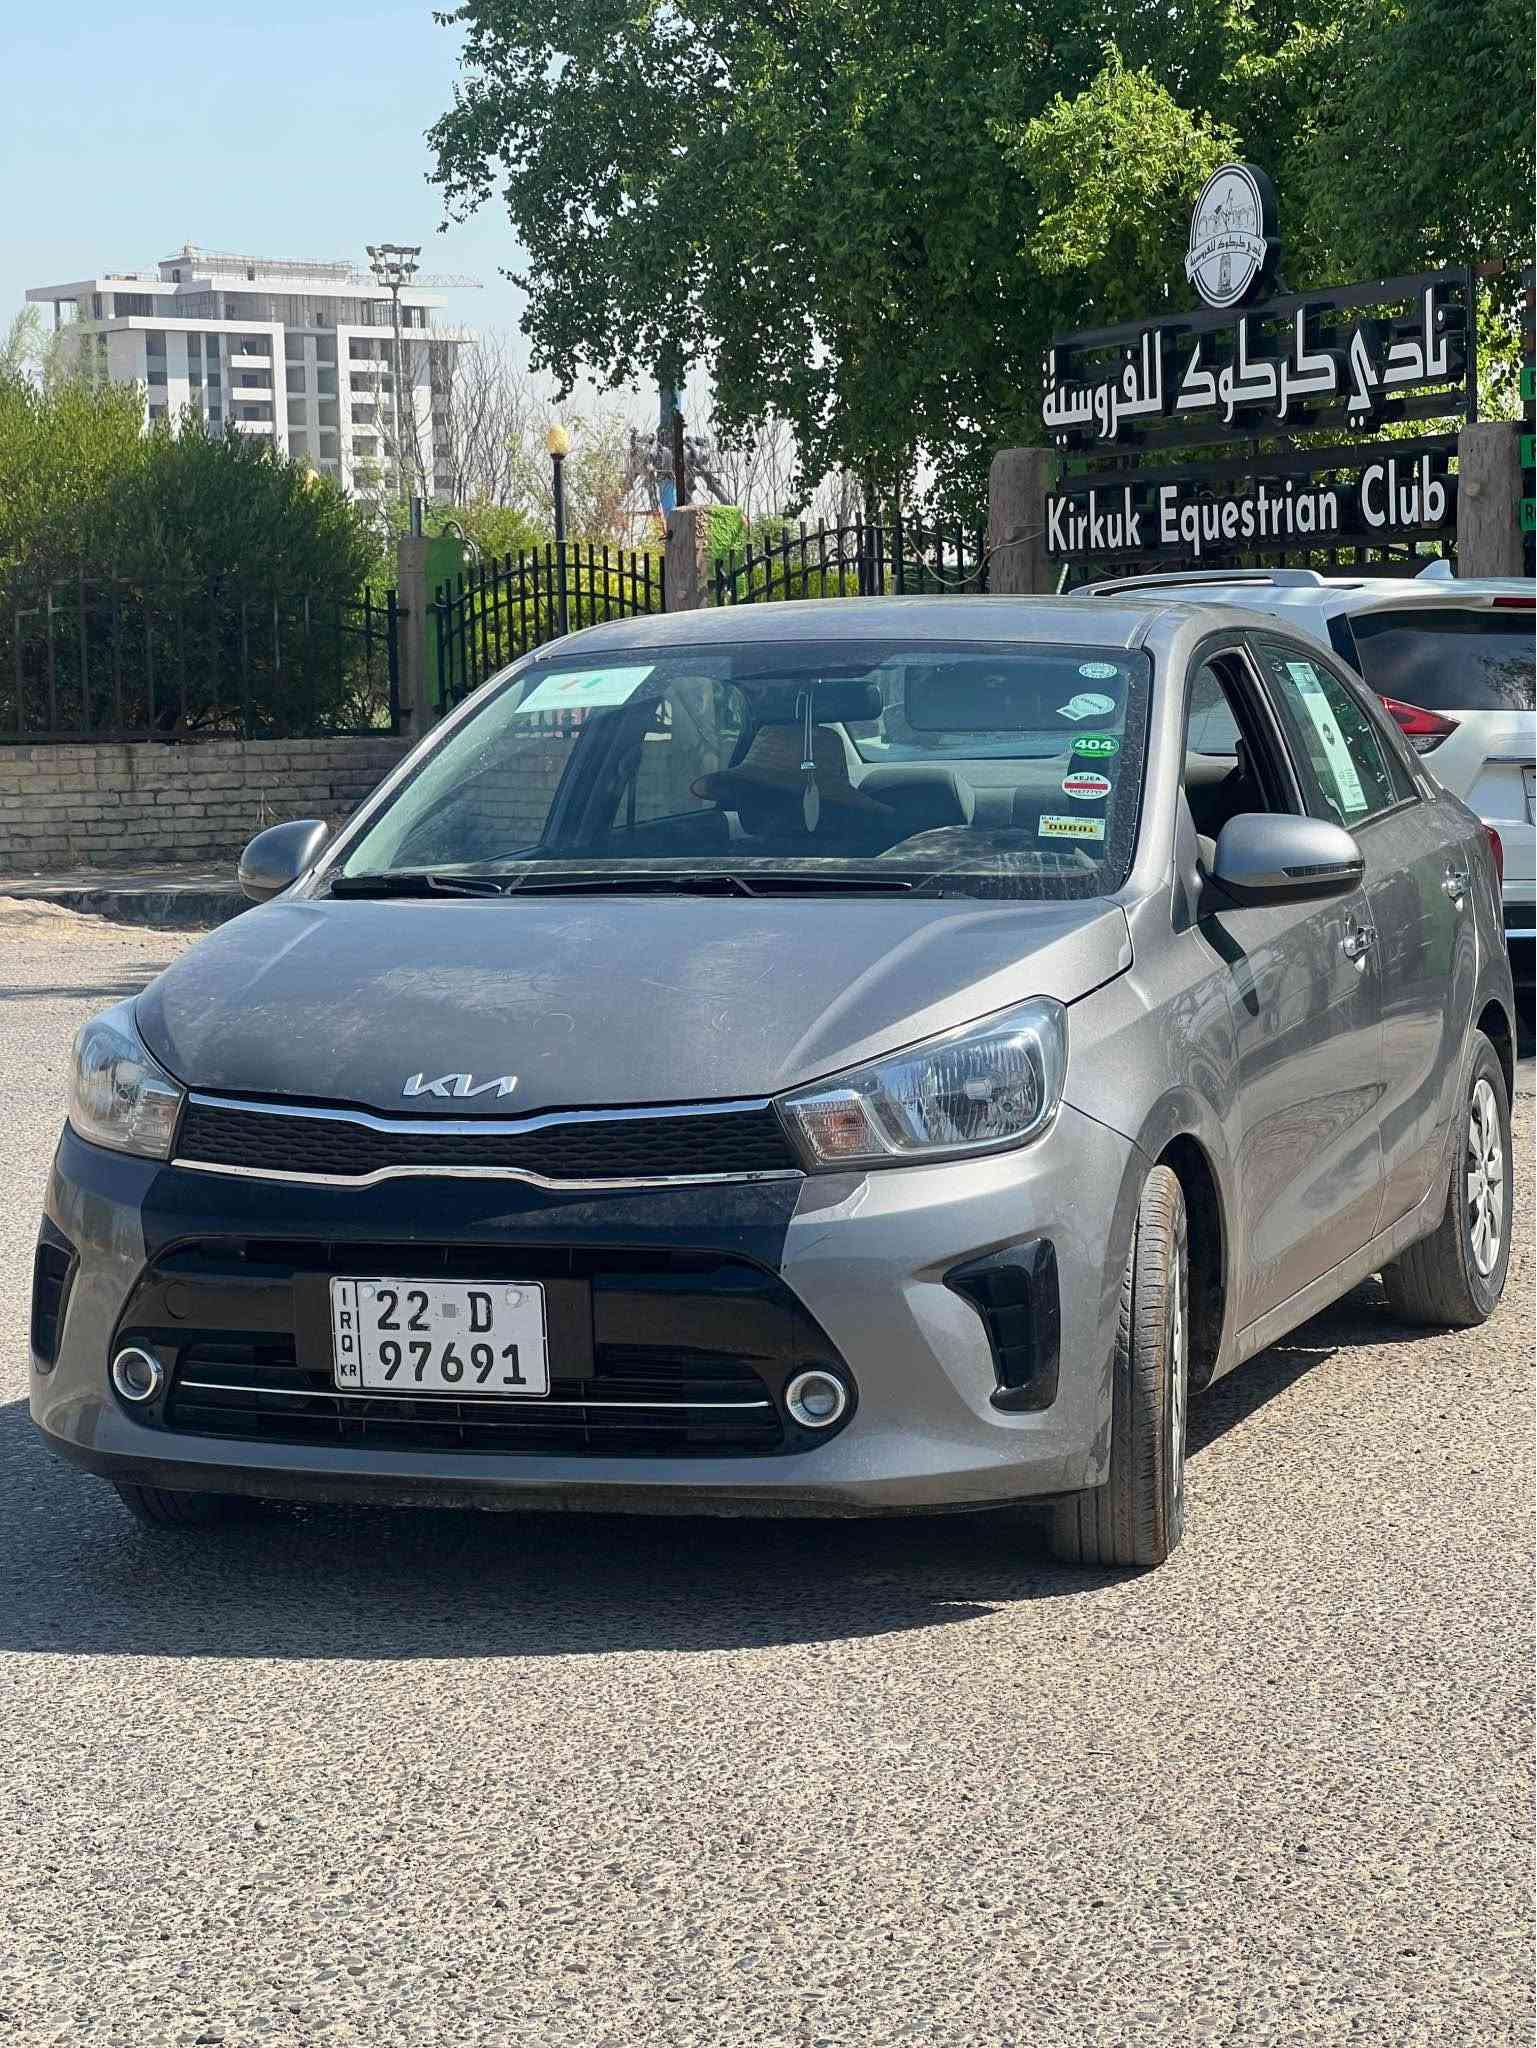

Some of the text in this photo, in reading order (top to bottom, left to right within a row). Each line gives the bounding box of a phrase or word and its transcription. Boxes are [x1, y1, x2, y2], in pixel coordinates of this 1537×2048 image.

[1042, 287, 1447, 447] نادي كركوك للفروسية
[1047, 456, 1446, 556] Kirkuk Equestrian Club
[1074, 739, 1115, 751] 404
[402, 1072, 518, 1098] KIA
[376, 1290, 494, 1333] 22 D
[340, 1364, 357, 1377] KR
[378, 1340, 527, 1385] 97691
